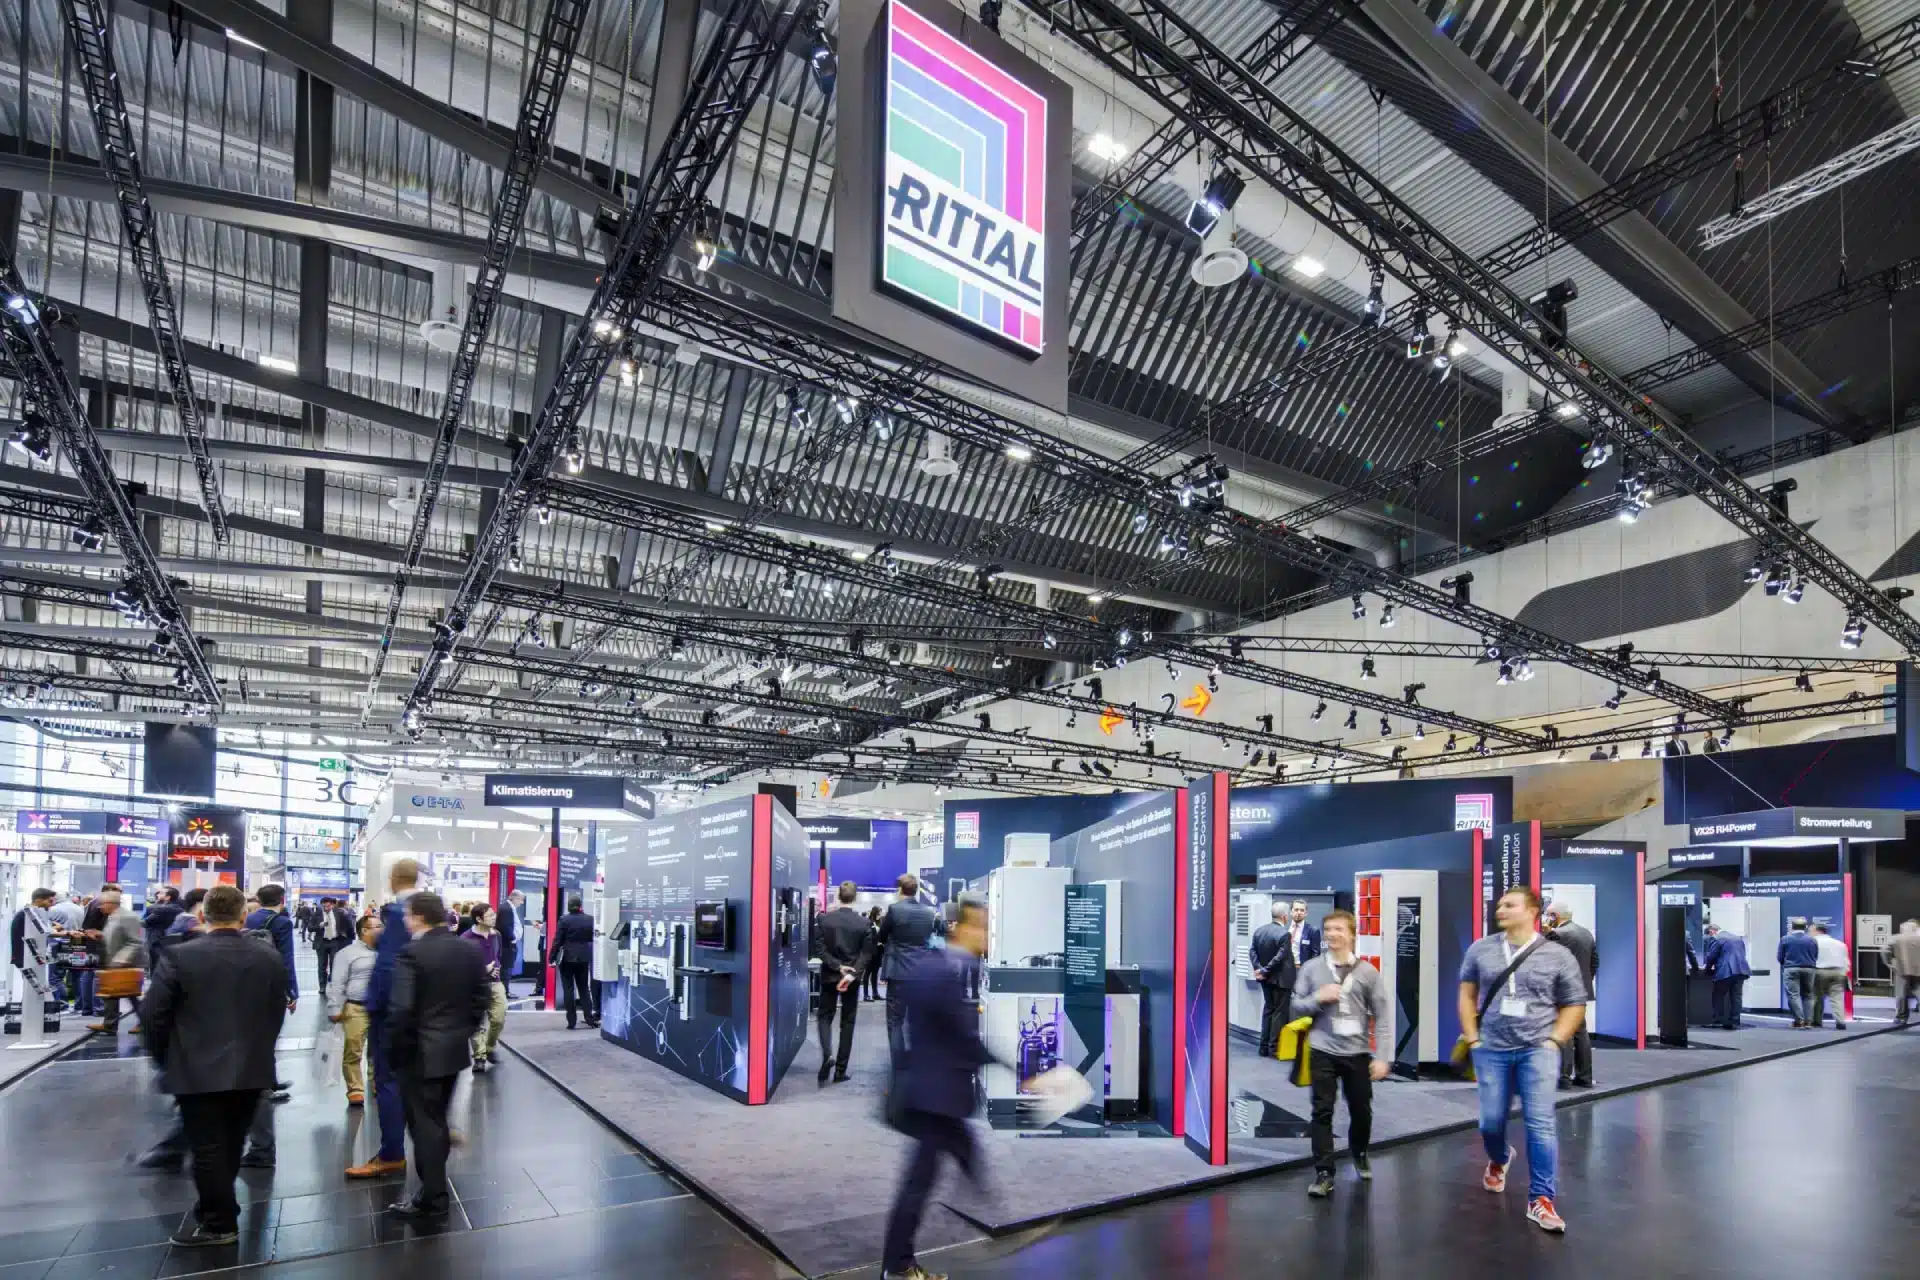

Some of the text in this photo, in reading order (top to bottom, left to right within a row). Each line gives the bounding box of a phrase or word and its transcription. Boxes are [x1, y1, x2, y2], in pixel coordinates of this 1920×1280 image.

[889, 171, 1041, 292] RITTAL
[1161, 693, 1177, 721] 2
[315, 777, 357, 805] 3C
[492, 785, 573, 798] Klimatisierung
[811, 782, 817, 798] 2
[1199, 791, 1207, 846] Control
[1457, 820, 1491, 828] RITTAL
[1800, 817, 1873, 829] Stromverteilung
[1694, 826, 1715, 836] VX25
[1192, 794, 1200, 910] Klimatisierung
[1687, 851, 1715, 861] Terminal
